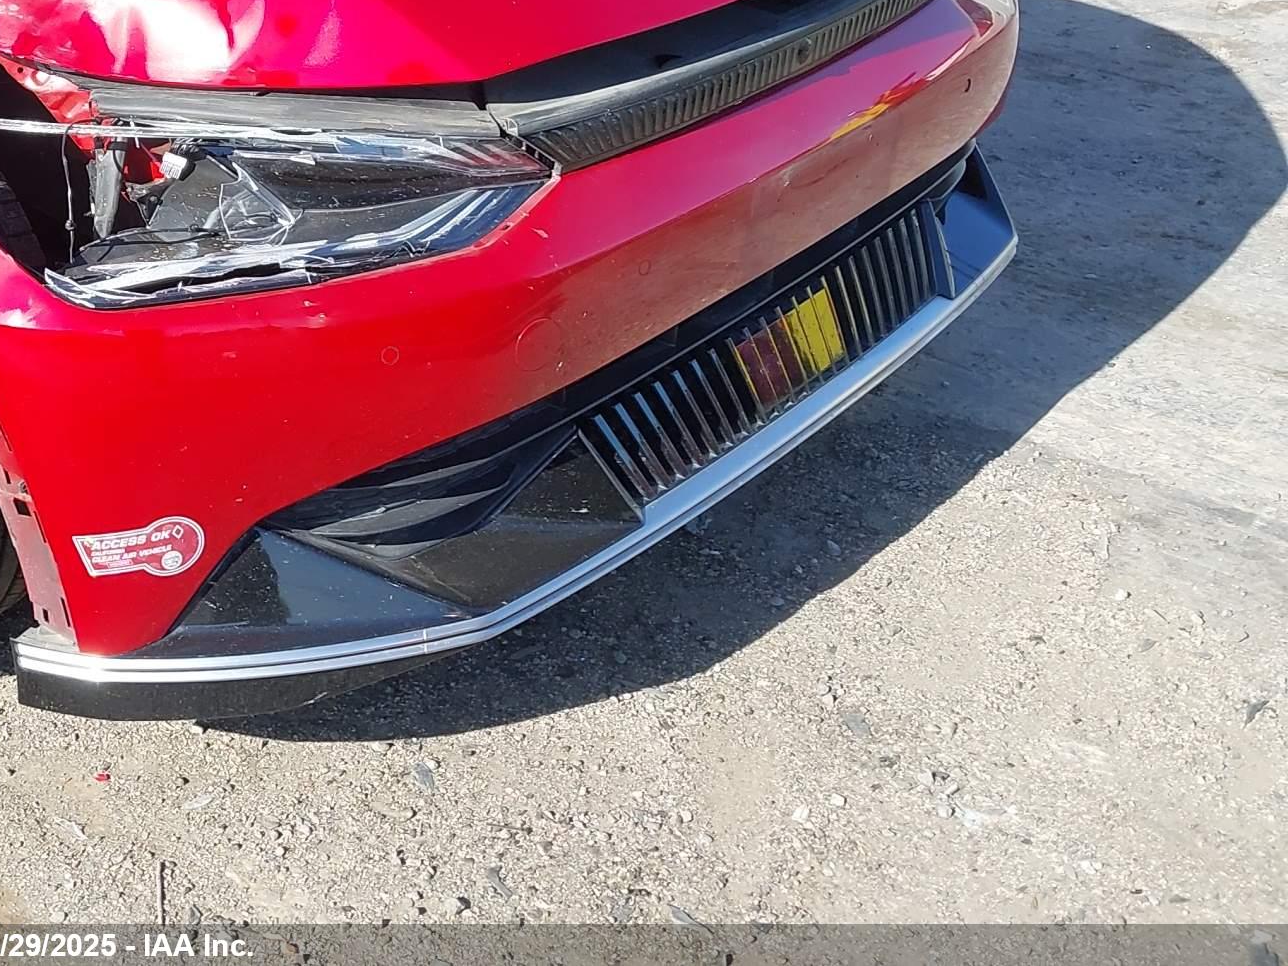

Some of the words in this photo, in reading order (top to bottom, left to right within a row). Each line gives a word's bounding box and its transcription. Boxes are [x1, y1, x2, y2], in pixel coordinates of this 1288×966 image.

[91, 534, 147, 550] ACCESS
[150, 529, 172, 542] OK
[91, 555, 120, 563] CLEAN
[120, 552, 137, 560] AIR
